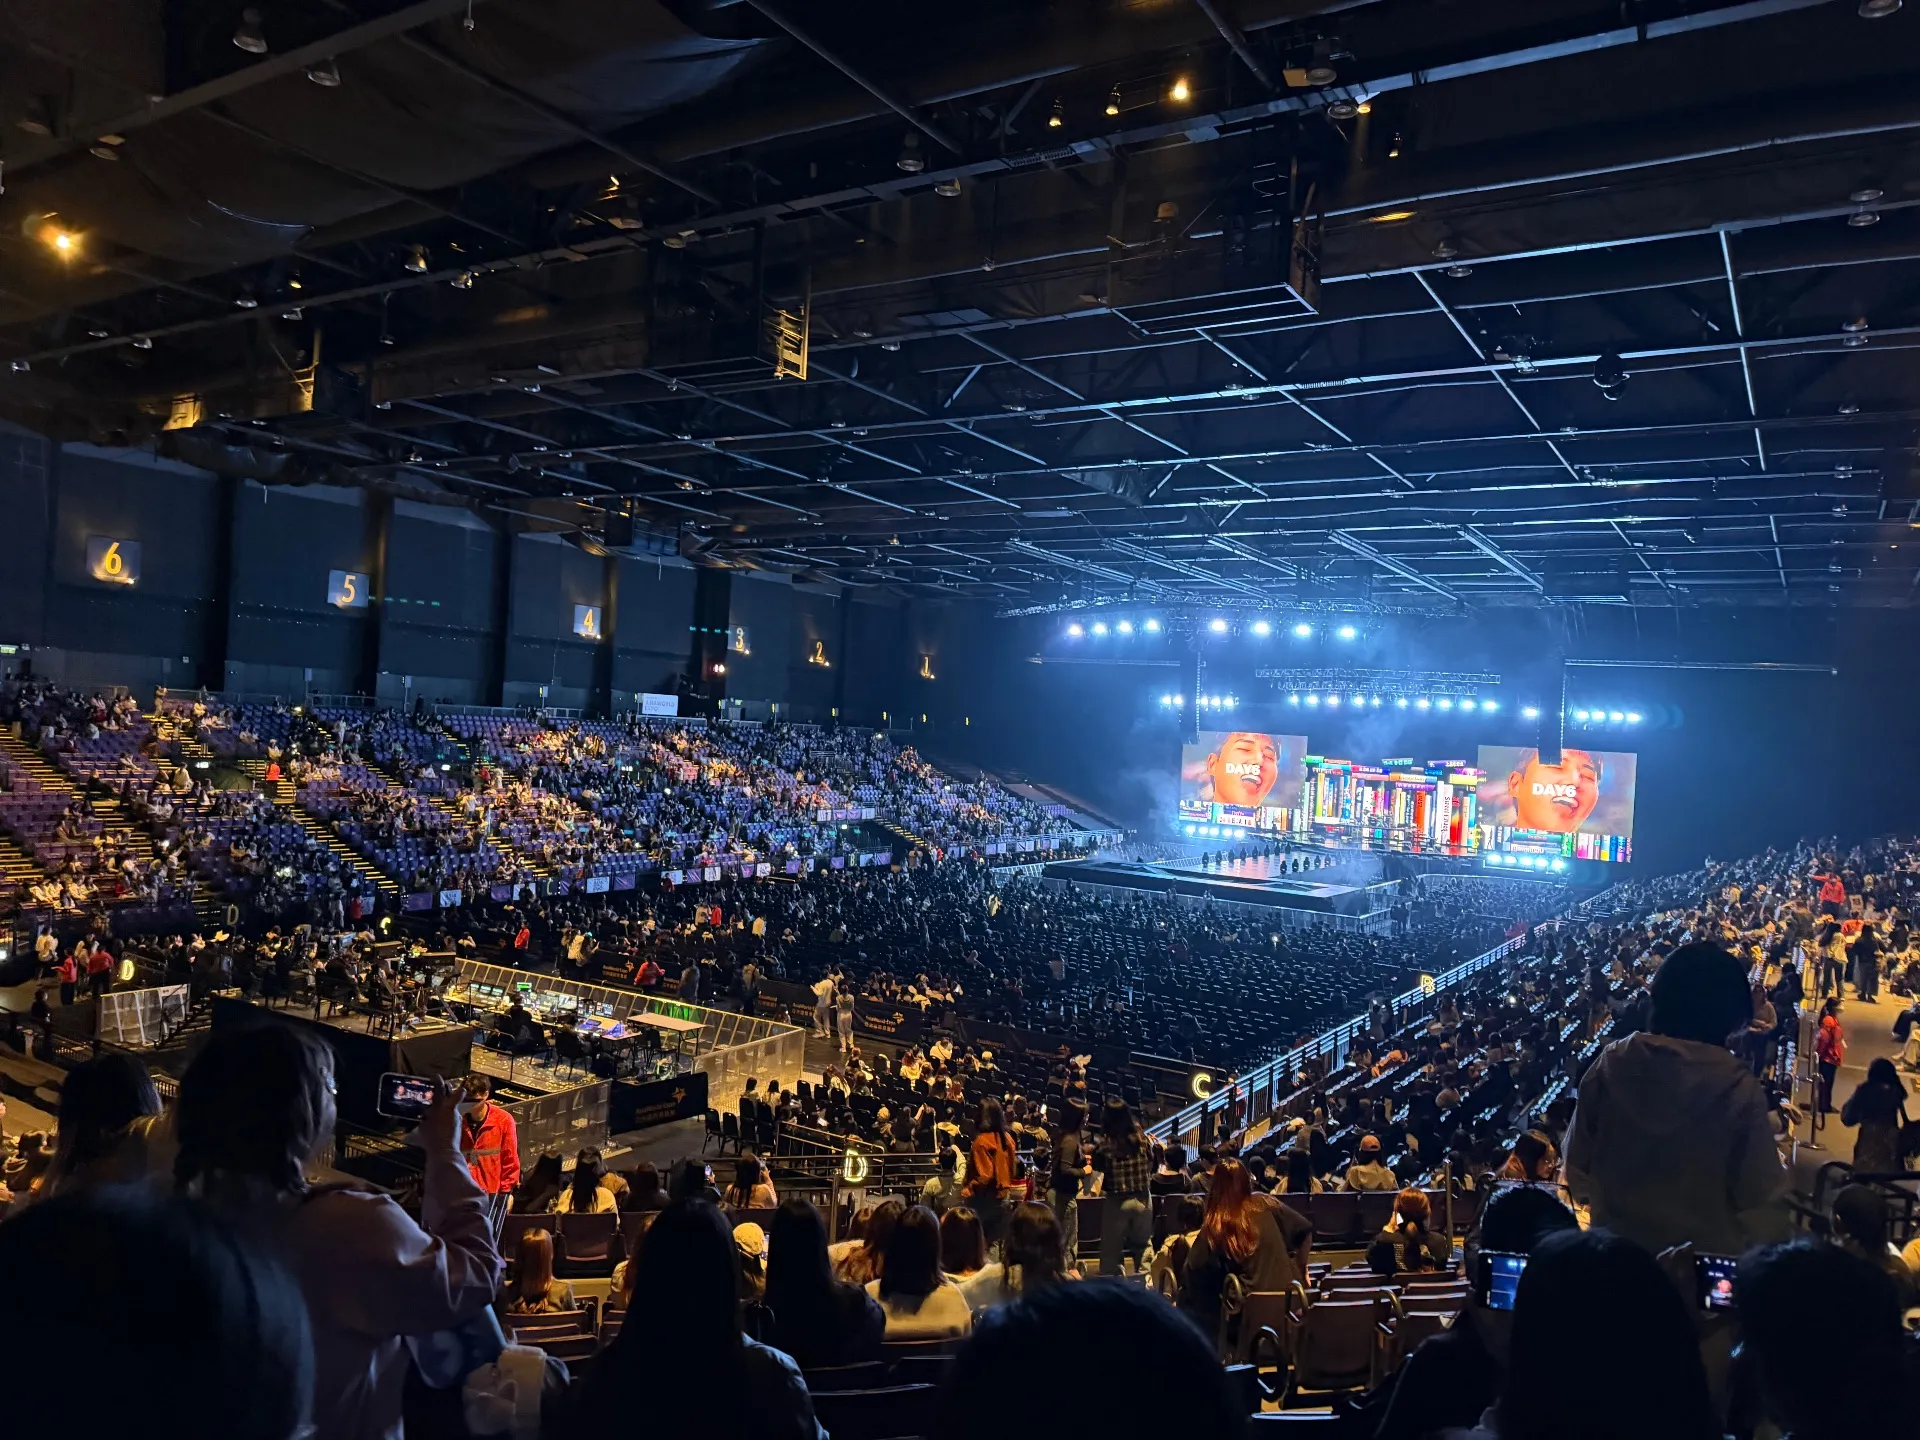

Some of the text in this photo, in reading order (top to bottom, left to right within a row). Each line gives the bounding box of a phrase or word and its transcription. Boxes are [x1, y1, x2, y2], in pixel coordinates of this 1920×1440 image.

[105, 542, 122, 574] 6
[341, 574, 356, 603] 5
[583, 609, 593, 633] 4
[735, 628, 745, 651] 3
[816, 642, 823, 660] 2
[924, 657, 929, 676] 1
[1225, 762, 1261, 776] DAY6
[1532, 782, 1576, 798] DAY6
[227, 905, 239, 924] D
[120, 959, 135, 981] D
[1421, 975, 1434, 993] B
[1192, 1073, 1211, 1098] C
[844, 1149, 868, 1183] D
